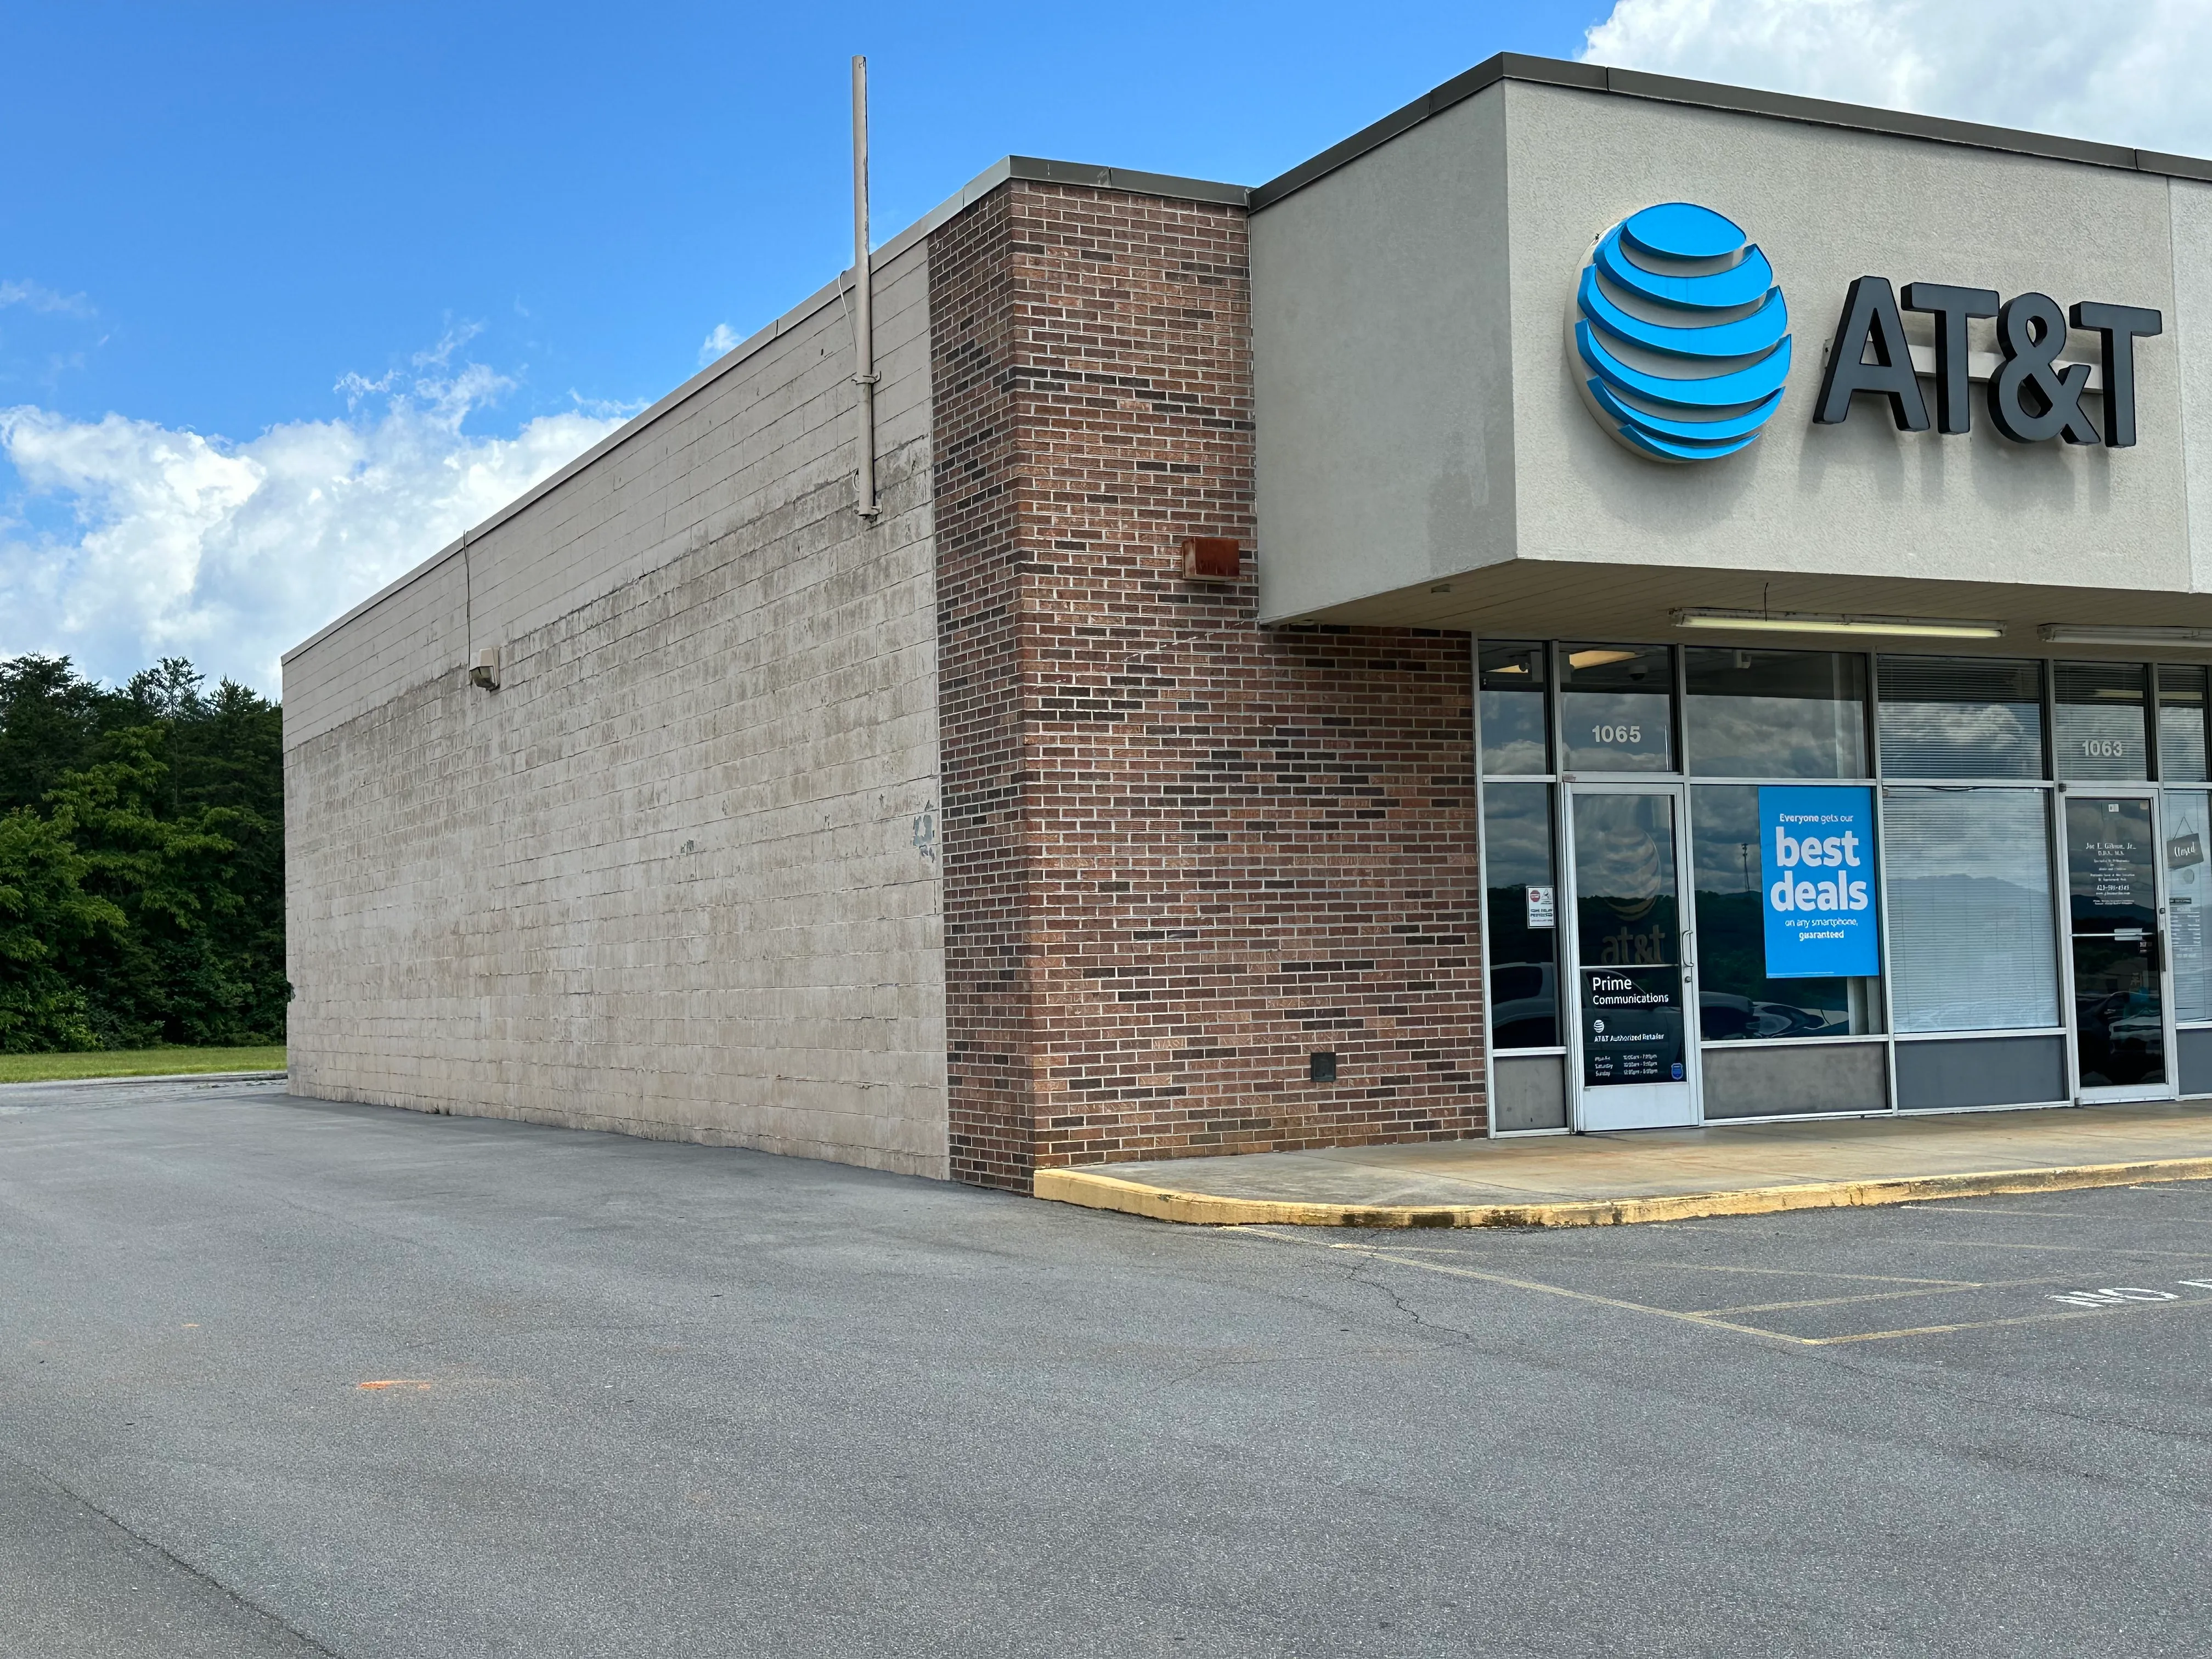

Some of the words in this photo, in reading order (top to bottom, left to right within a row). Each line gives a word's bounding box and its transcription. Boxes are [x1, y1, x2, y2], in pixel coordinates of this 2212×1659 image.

[1813, 275, 2163, 448] AT&T
[1592, 725, 1641, 743] 1065
[2082, 739, 2123, 757] 1063
[1780, 814, 1819, 825] Everyone
[1821, 814, 1838, 825] gets
[1776, 826, 1861, 867] best
[1770, 870, 1869, 912] deals
[1797, 919, 1810, 928] any
[1593, 976, 1632, 991] Prime
[1593, 992, 1669, 1005] Communications
